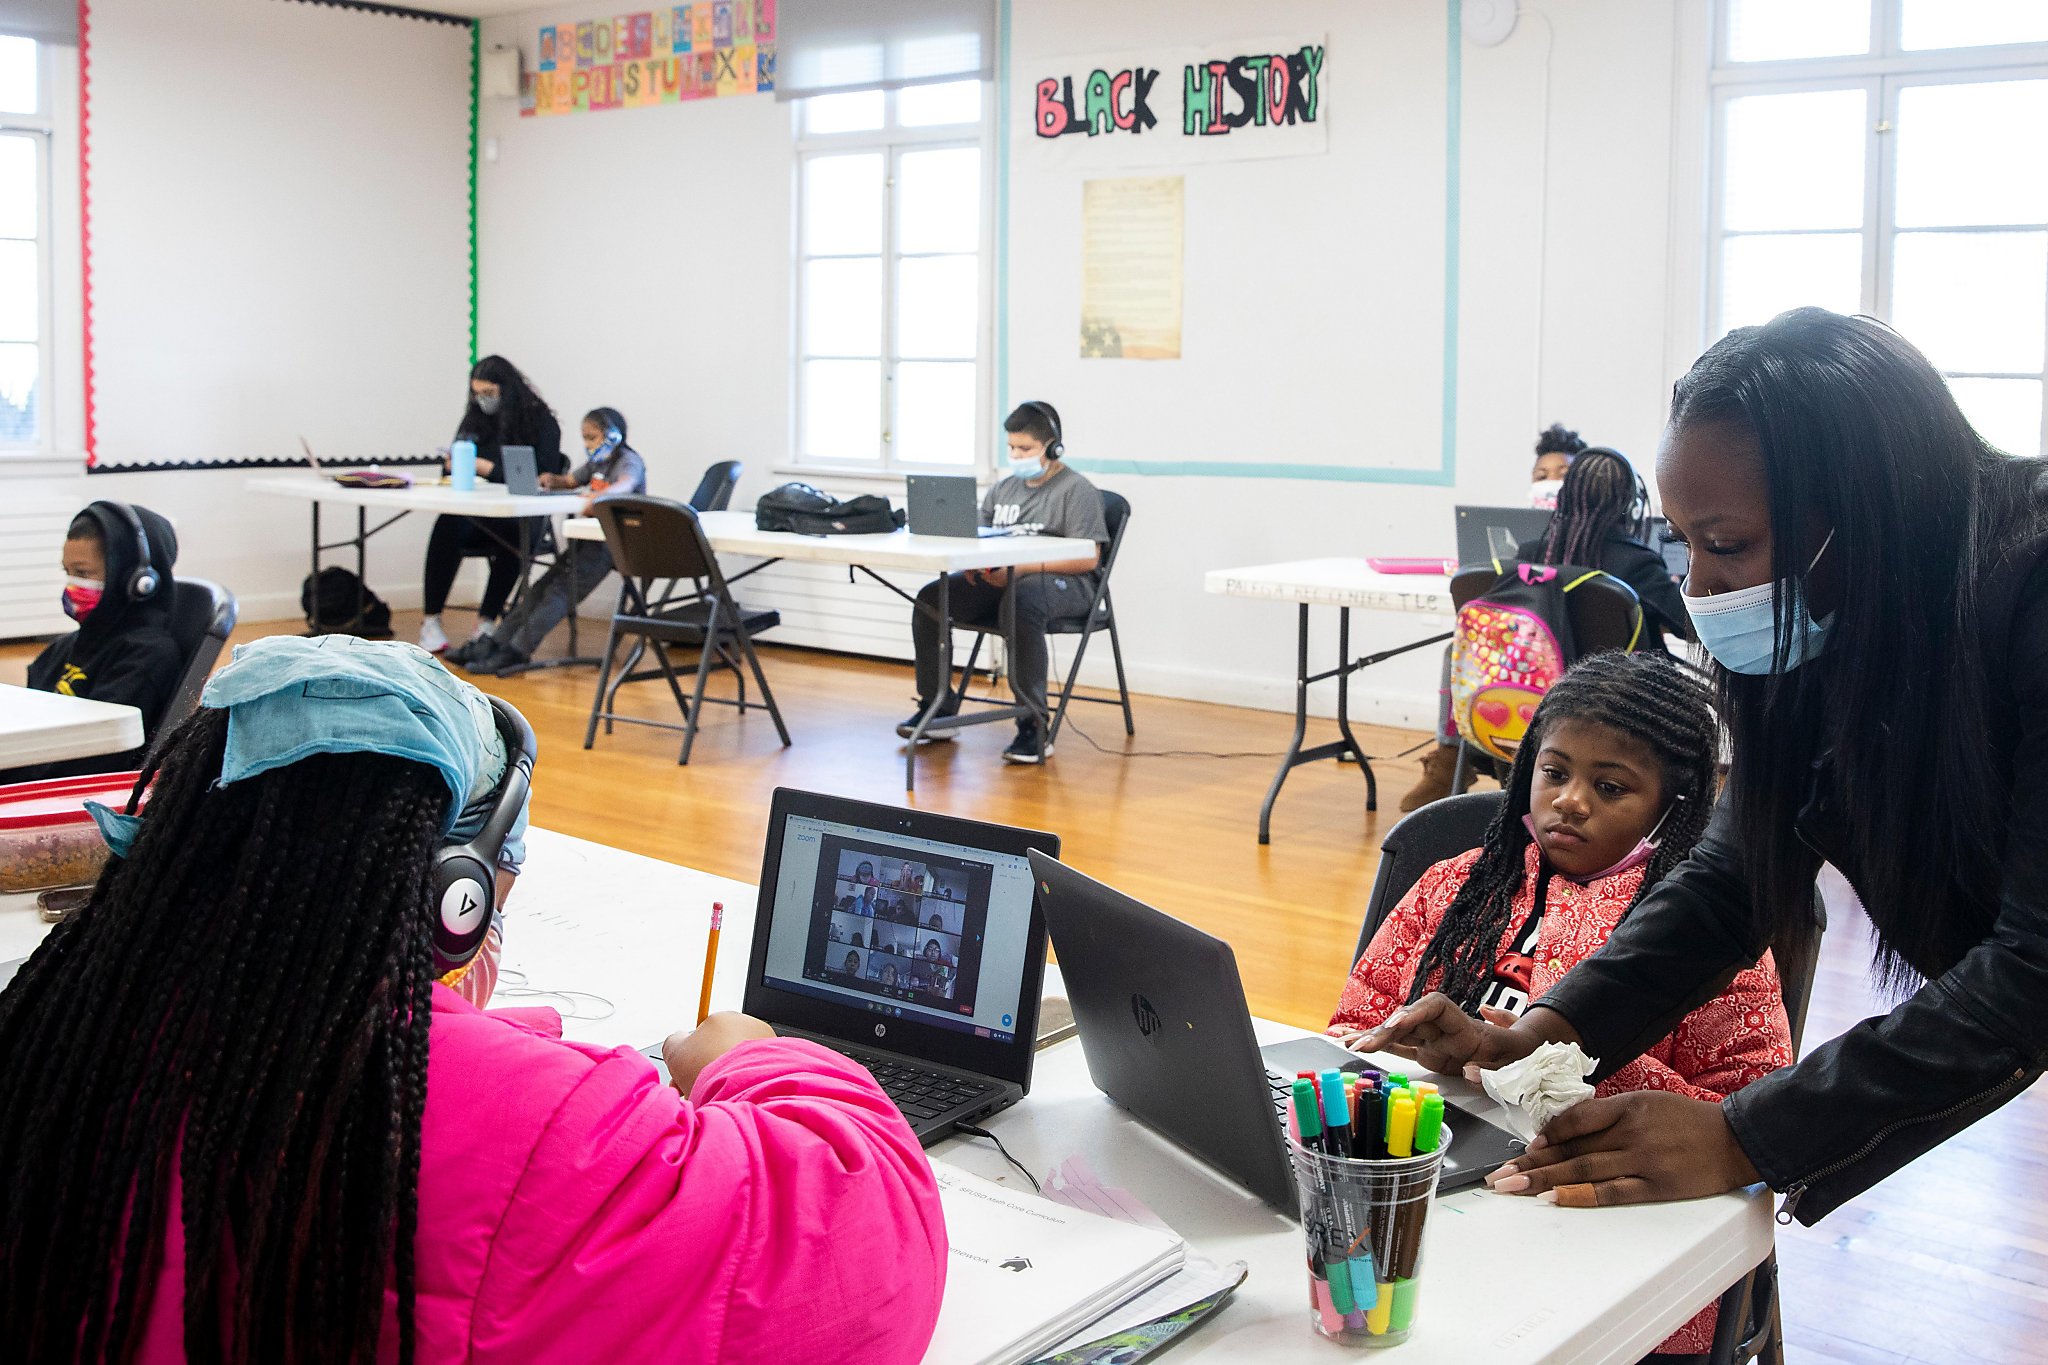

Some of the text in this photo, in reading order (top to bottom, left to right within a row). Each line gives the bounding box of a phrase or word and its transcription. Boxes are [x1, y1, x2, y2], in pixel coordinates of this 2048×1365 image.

[1036, 45, 1324, 138] BLACK HISTORY
[797, 833, 816, 843] zoom
[1006, 1203, 1025, 1213] Core
